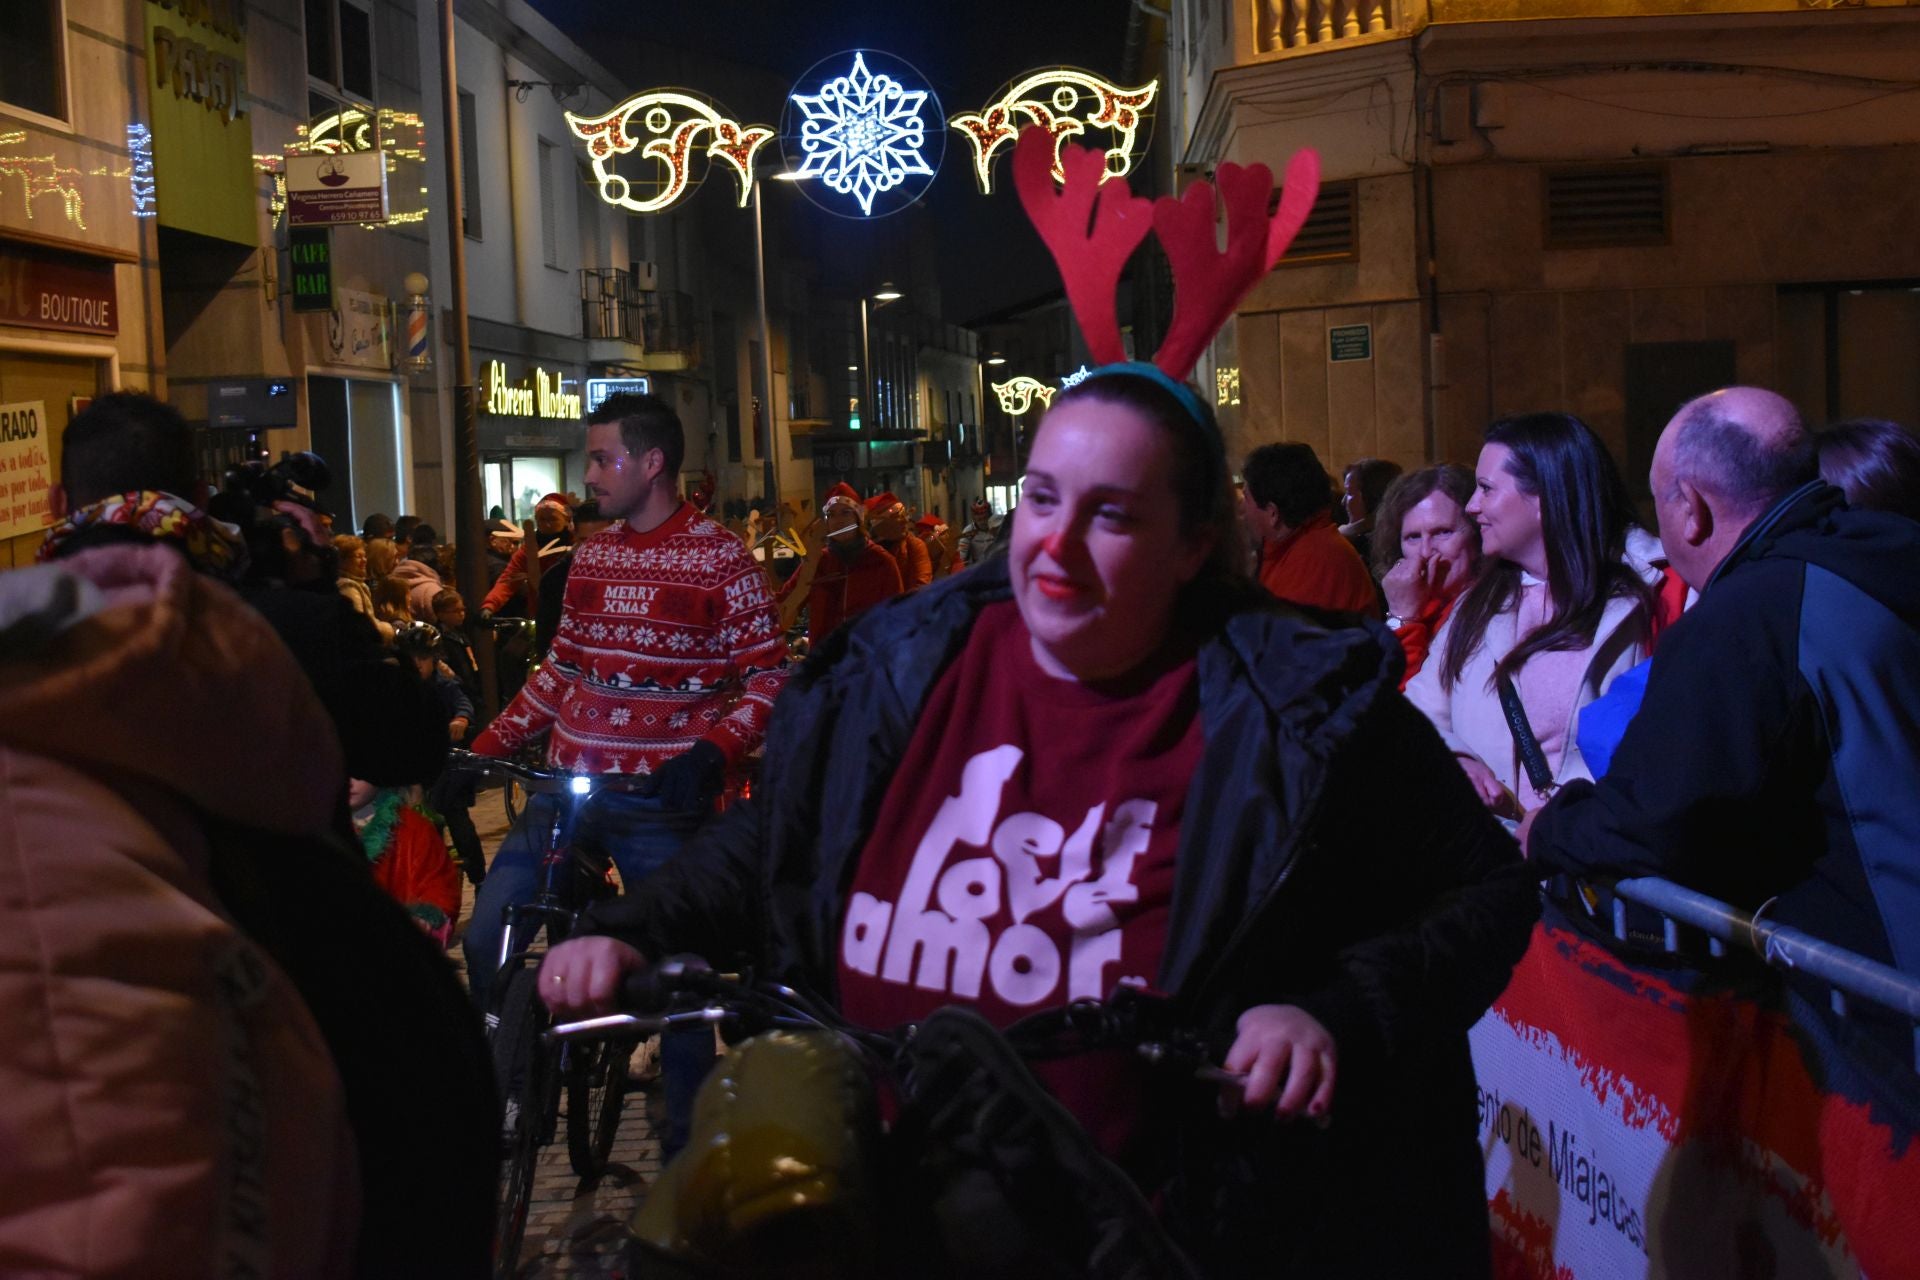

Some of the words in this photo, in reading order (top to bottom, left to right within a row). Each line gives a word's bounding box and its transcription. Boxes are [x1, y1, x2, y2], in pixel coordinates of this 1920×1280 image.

[331, 212, 345, 221] 659
[347, 212, 357, 220] 10
[297, 274, 327, 295] BAR
[41, 293, 109, 327] BOUTIQUE
[536, 367, 581, 420] Moderna
[0, 409, 38, 442] RADO
[603, 585, 660, 600] MERRY
[603, 601, 650, 615] XMAS
[842, 890, 1123, 1005] amor
[1517, 1106, 1542, 1168] de
